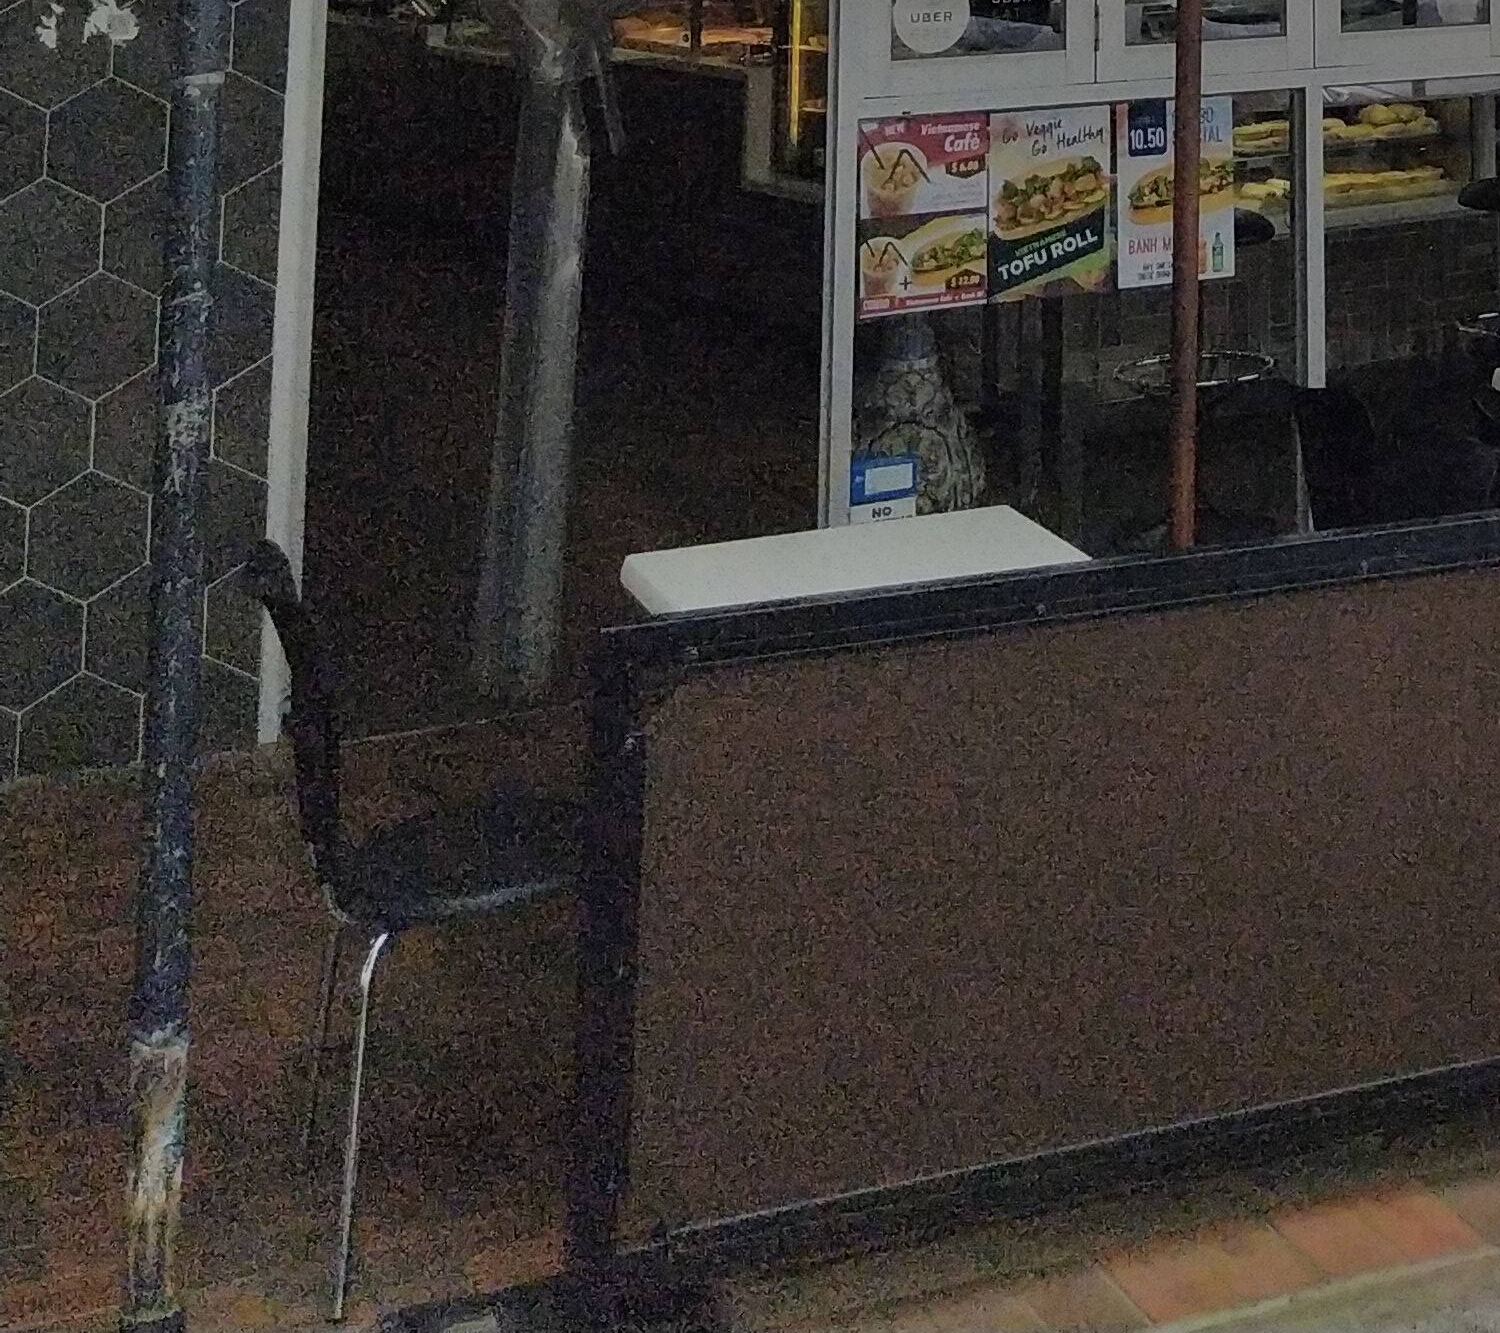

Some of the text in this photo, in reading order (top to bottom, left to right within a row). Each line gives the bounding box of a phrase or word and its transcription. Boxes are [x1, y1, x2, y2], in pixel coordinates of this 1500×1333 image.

[909, 10, 953, 24] UBER
[1026, 118, 1062, 141] Veggie
[1128, 126, 1165, 150] 10.50
[1032, 140, 1047, 157] Go
[998, 228, 1099, 281] TOFU ROLL
[1128, 237, 1158, 255] BANH
